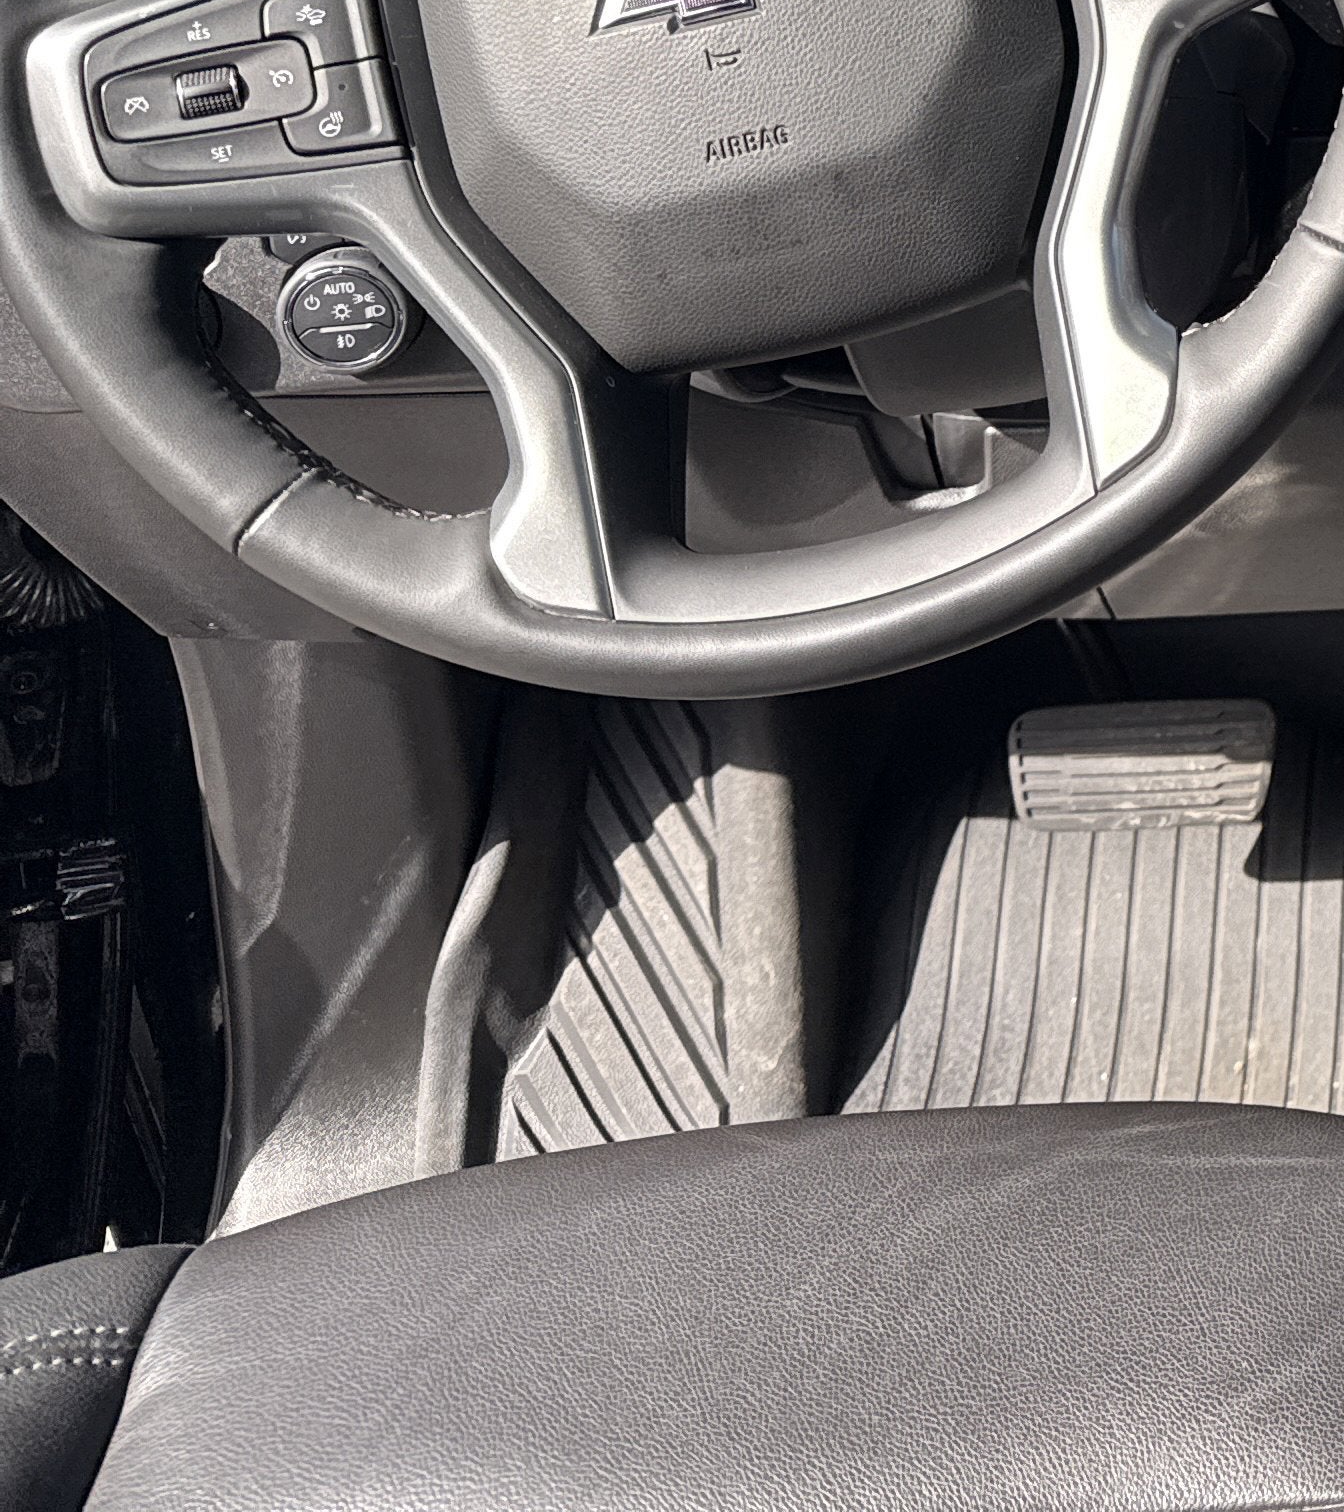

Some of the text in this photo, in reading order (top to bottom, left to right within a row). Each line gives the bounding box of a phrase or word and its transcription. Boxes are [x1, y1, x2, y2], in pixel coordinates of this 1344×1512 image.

[186, 27, 211, 42] RES
[704, 124, 789, 164] AIRBAG
[210, 144, 233, 160] SET
[323, 282, 356, 296] AUTO
